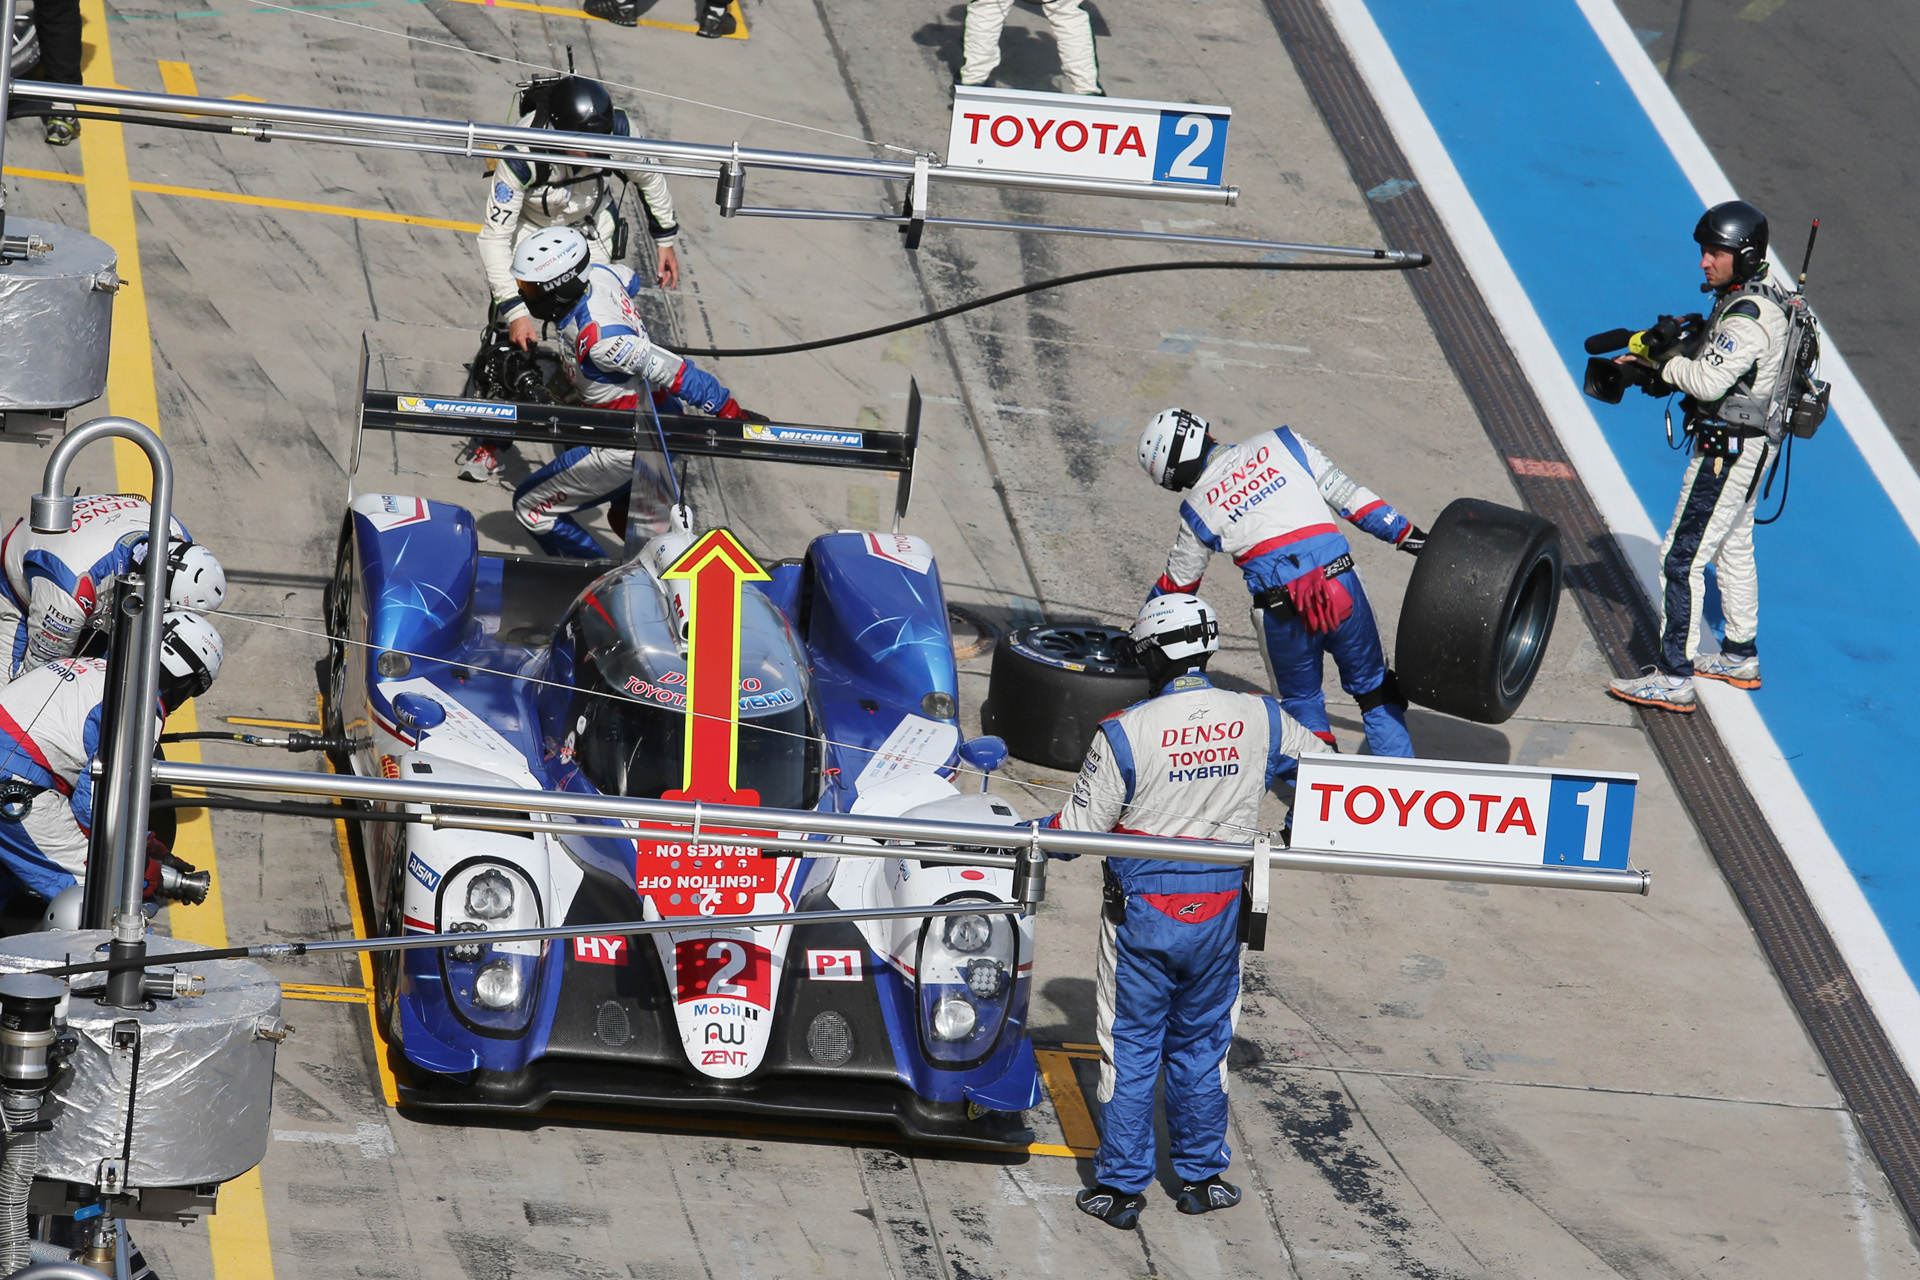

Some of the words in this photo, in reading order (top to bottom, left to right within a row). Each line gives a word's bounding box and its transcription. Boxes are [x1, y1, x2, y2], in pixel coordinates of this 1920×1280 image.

[963, 113, 1147, 158] TOYOTA
[1168, 113, 1215, 180] 2
[490, 205, 513, 226] 27
[542, 266, 579, 292] uvex
[433, 403, 515, 417] MICHELIN
[779, 430, 860, 445] MICHELIN
[1206, 446, 1270, 506] DENSO
[1218, 467, 1280, 512] TOYOTA
[1228, 476, 1287, 523] HYBRID
[381, 495, 399, 513] BRID
[1134, 635, 1160, 655] uvex
[46, 662, 76, 682] BRID
[738, 688, 796, 710] YBRID
[1161, 721, 1244, 748] DENSO
[1169, 746, 1240, 767] TOYOTA
[1169, 763, 1240, 782] HYBRID
[1311, 783, 1538, 836] TOYOTA
[1576, 782, 1609, 862] 1
[656, 844, 682, 857] ON
[687, 844, 758, 857] BRAKES
[409, 857, 437, 887] AISIN
[638, 876, 672, 889] OFF
[677, 874, 758, 889] IGNITION
[577, 936, 622, 960] HY
[706, 941, 748, 998] 2
[816, 955, 853, 976] P1
[694, 1003, 741, 1017] Mobil
[745, 1006, 759, 1020] 1
[701, 1050, 748, 1066] ZENT
